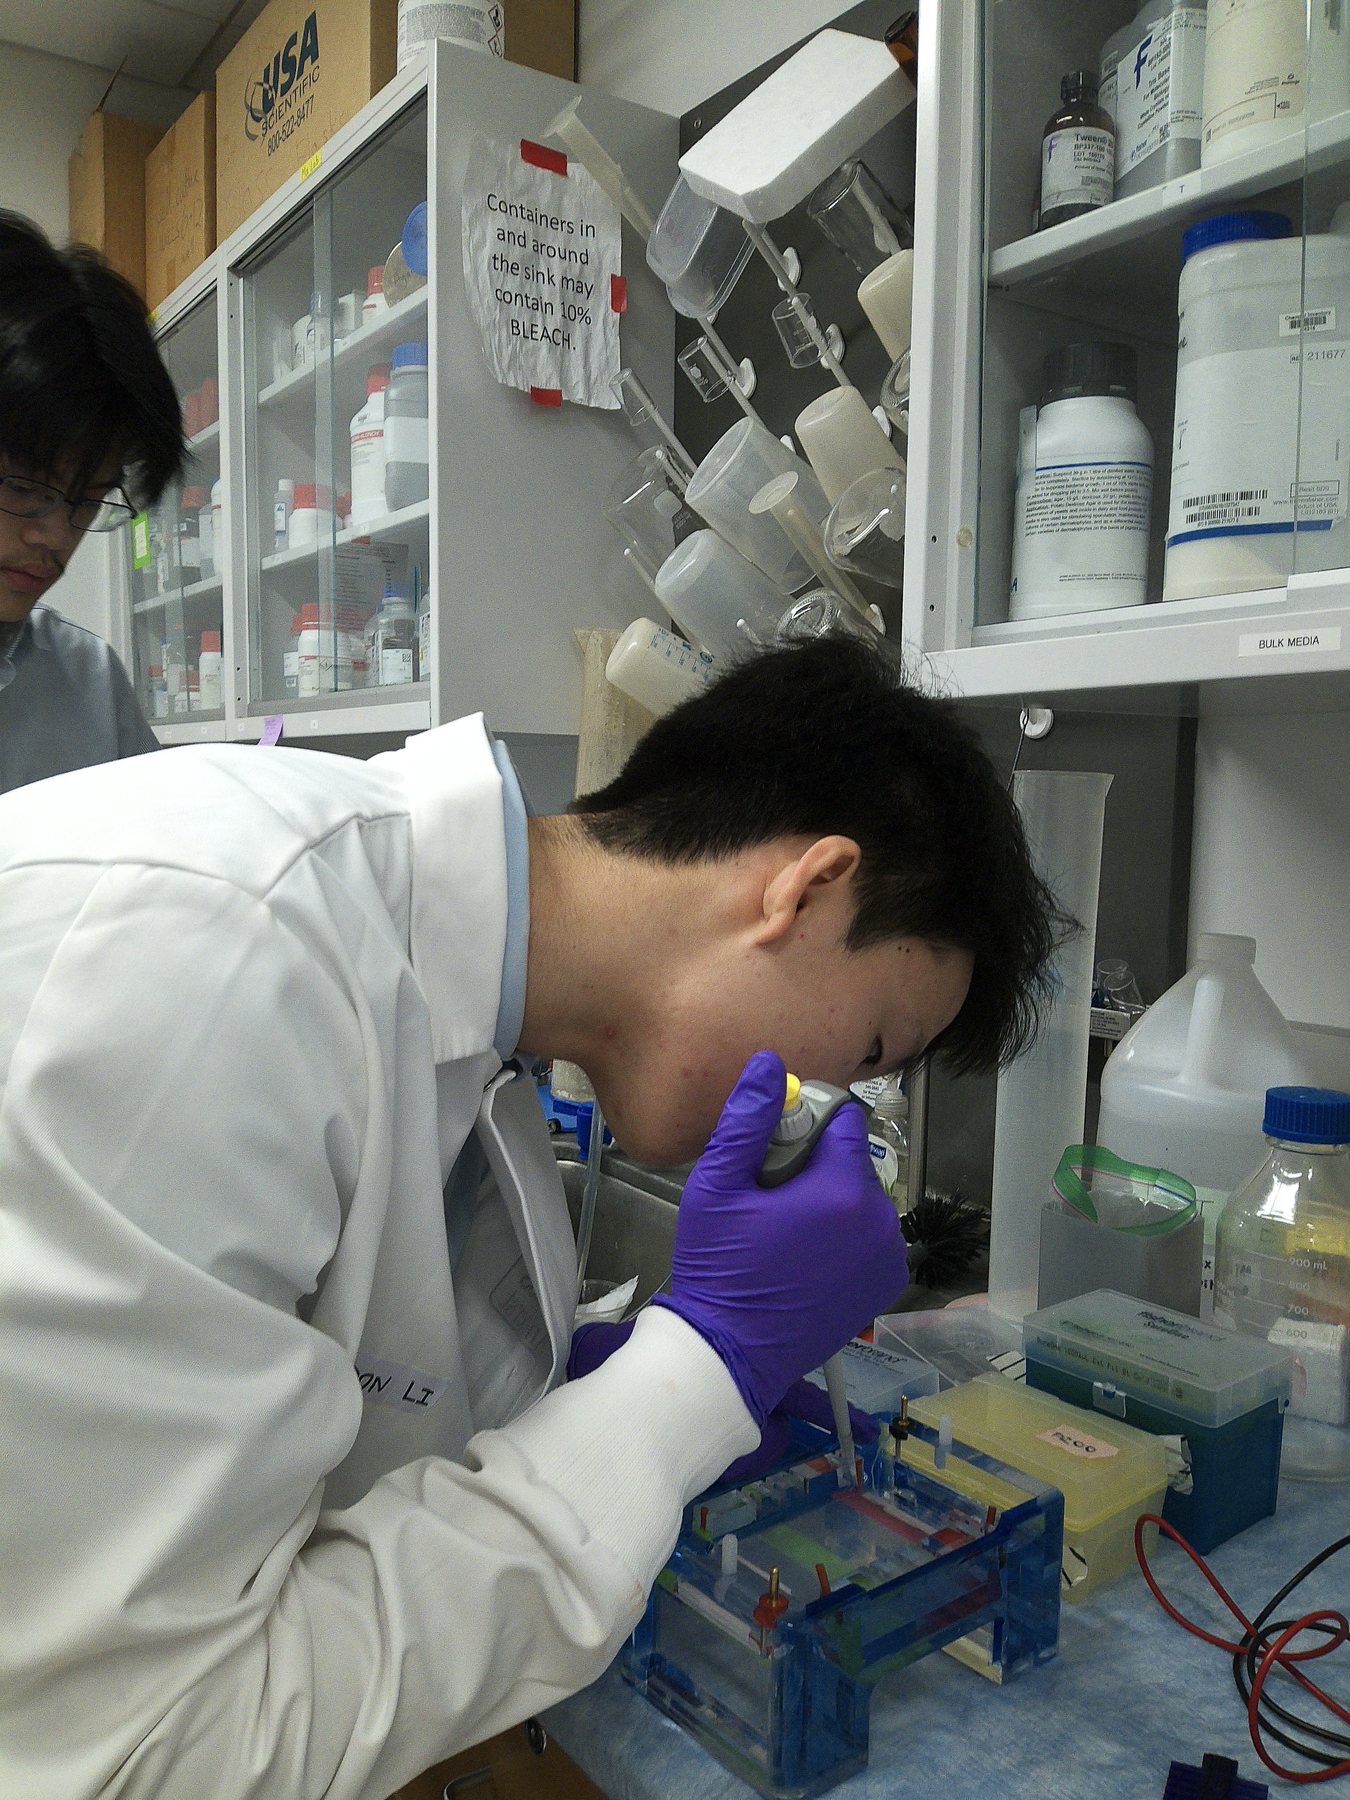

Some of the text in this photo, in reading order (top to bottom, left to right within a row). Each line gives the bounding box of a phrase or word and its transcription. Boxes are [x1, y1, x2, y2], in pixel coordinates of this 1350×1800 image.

[262, 10, 319, 114] USA
[261, 65, 320, 137] SCIENTIFIC
[267, 95, 315, 157] 800-522-8477
[486, 193, 596, 239] Containers in
[496, 227, 589, 266] and around
[492, 253, 594, 300] the sink may
[495, 288, 592, 326] contain 10%
[511, 318, 576, 351] BLEACH.
[1307, 349, 1346, 362] 211677
[1258, 635, 1320, 650] BULK MEDIA
[1289, 1256, 1311, 1269] 900
[1287, 1303, 1309, 1316] 700
[1286, 1328, 1308, 1340] 600
[401, 1380, 434, 1407] LI
